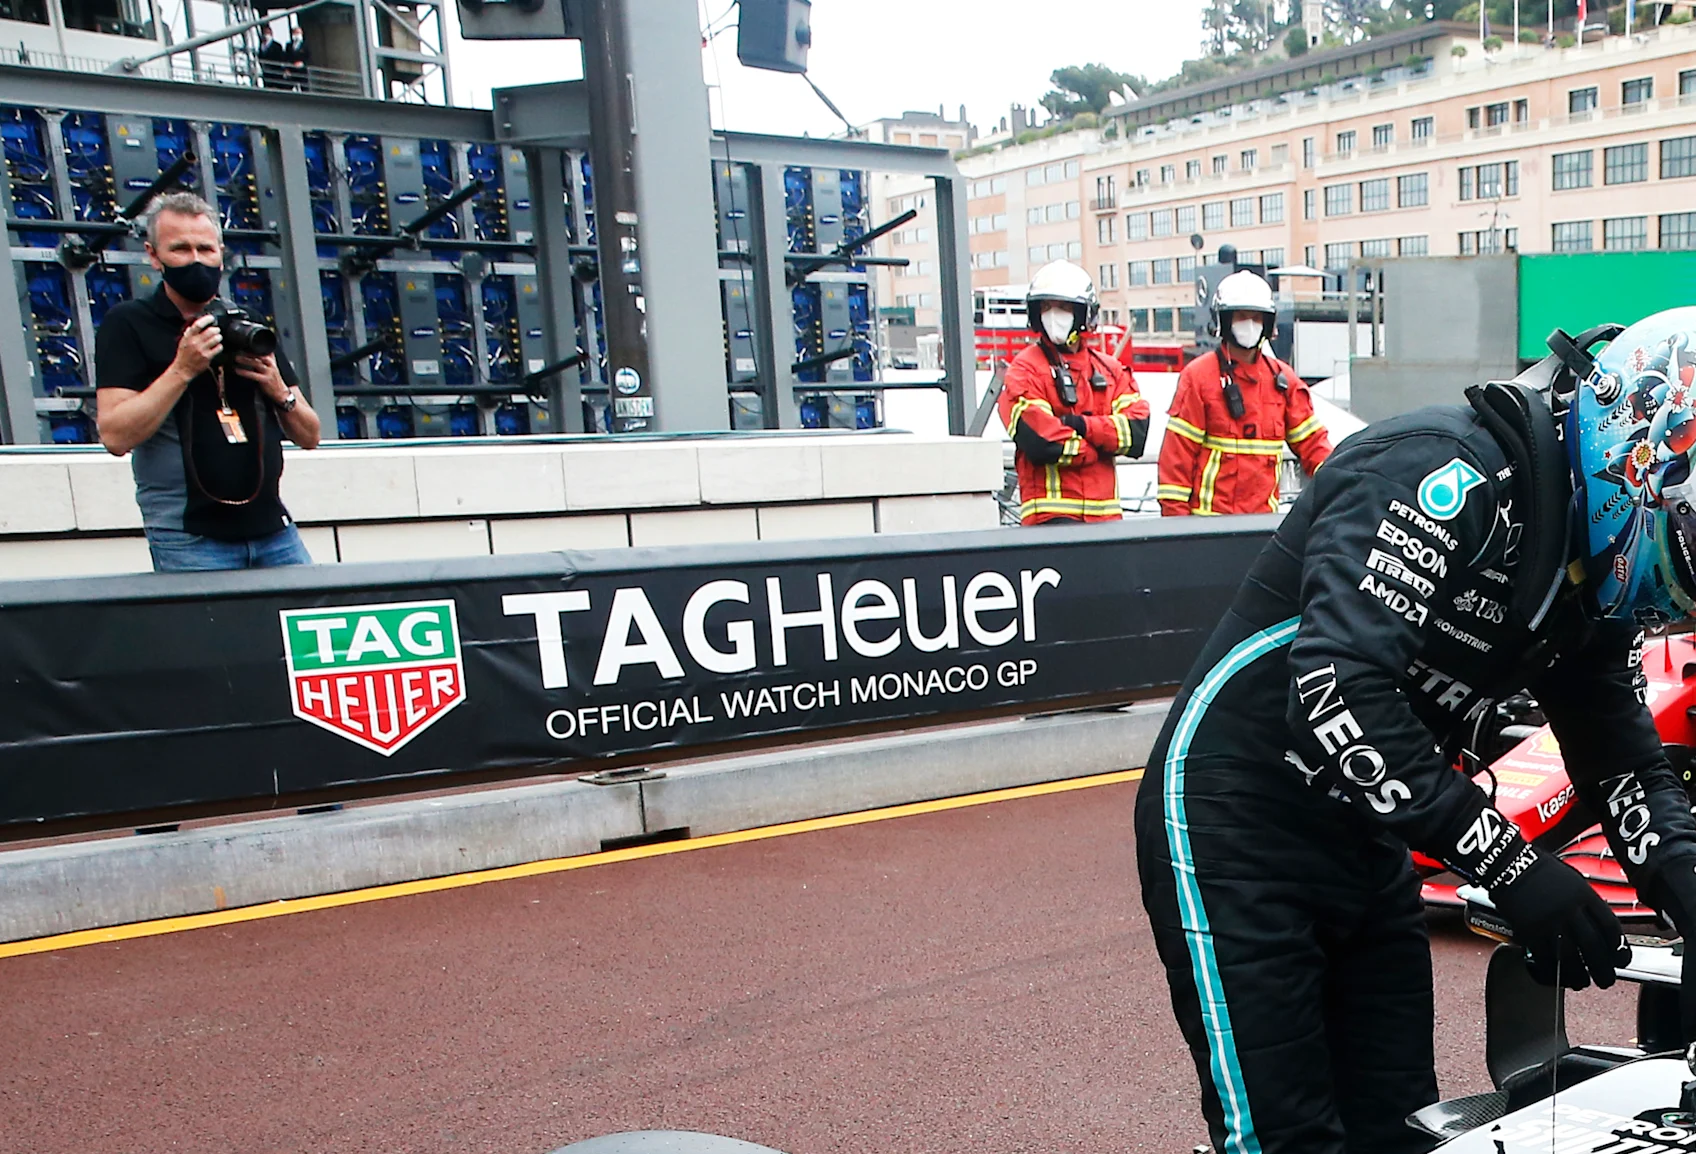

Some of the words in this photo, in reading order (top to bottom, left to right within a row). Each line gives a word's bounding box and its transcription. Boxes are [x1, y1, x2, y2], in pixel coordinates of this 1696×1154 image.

[1376, 518, 1448, 579] EPSON
[1388, 499, 1459, 552] PETRONAS
[1675, 529, 1692, 566] POLICE
[1358, 572, 1413, 616] AMD
[1365, 547, 1436, 600] PIRELLI
[294, 608, 448, 664] TAG
[1475, 595, 1508, 625] UBS
[302, 664, 456, 748] HEUER
[545, 694, 713, 741] OFFICIAL
[720, 681, 842, 719] WATCH
[849, 665, 991, 702] MONACO
[994, 658, 1039, 687] GP
[1296, 662, 1413, 814] INEOS
